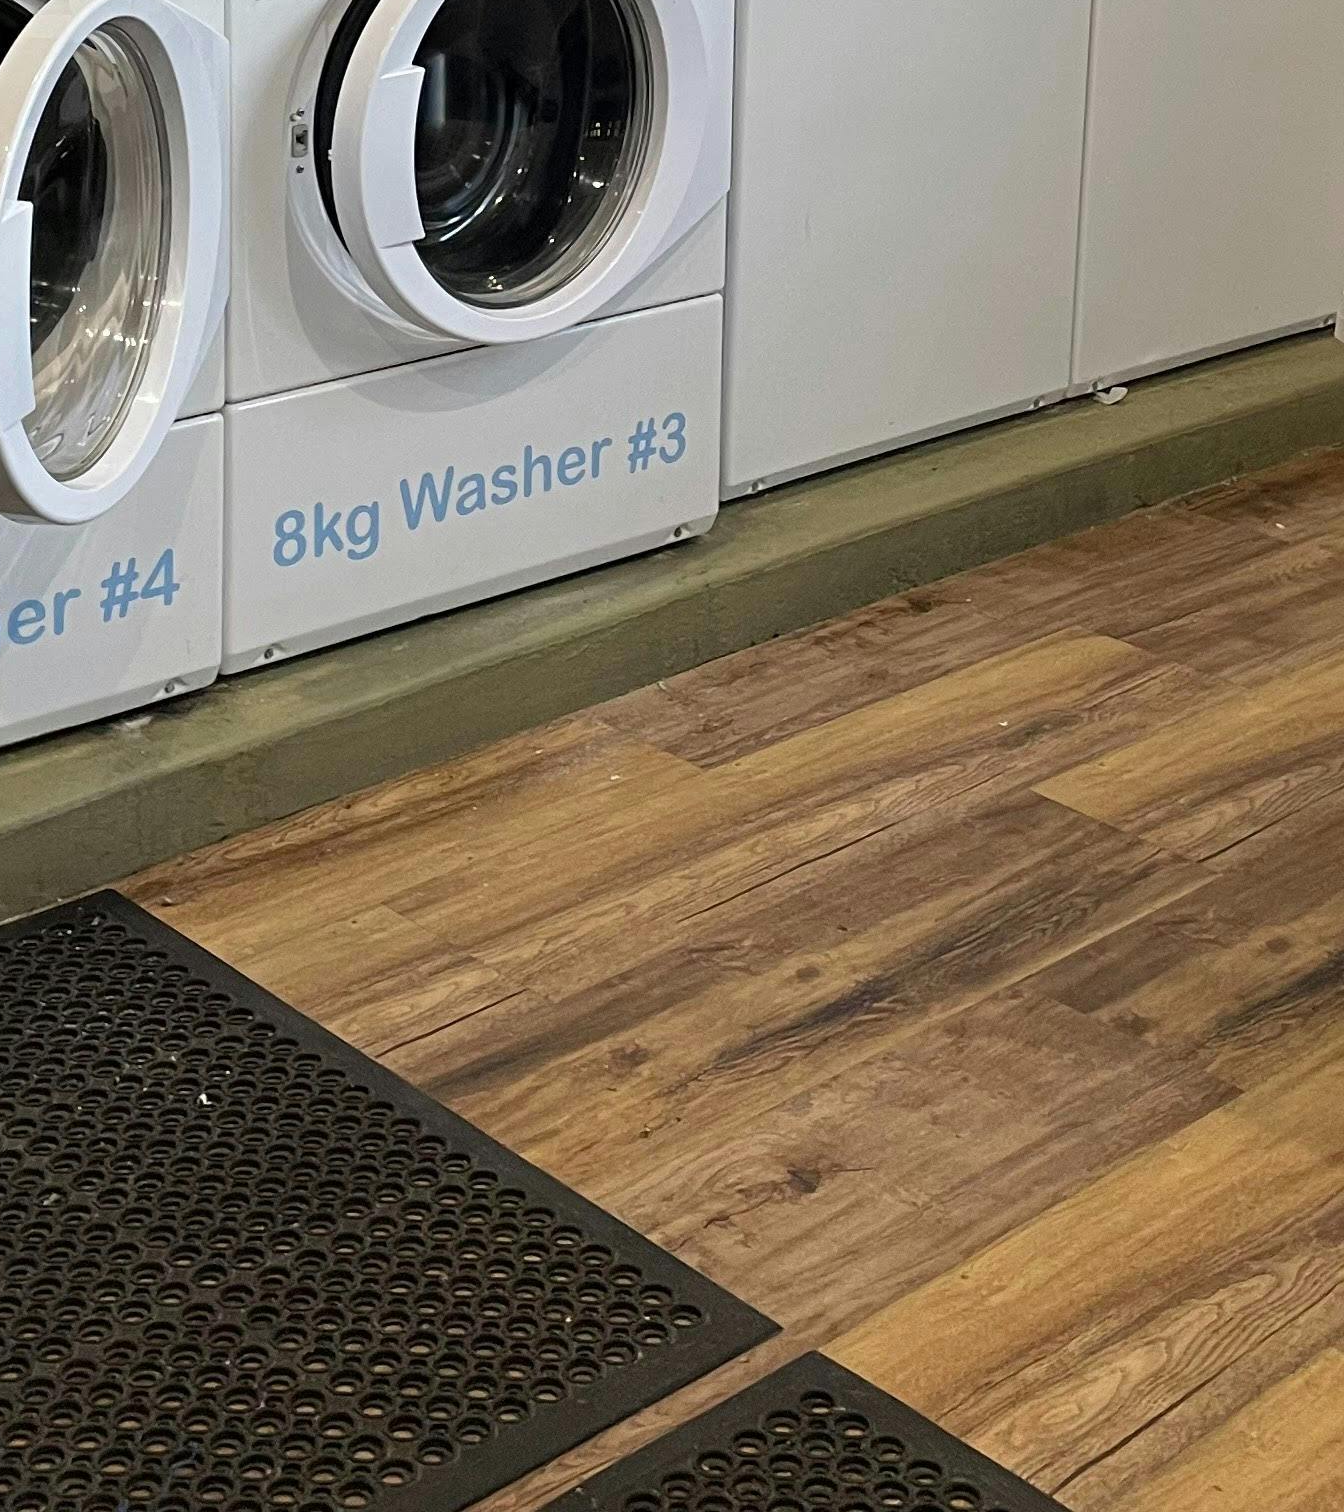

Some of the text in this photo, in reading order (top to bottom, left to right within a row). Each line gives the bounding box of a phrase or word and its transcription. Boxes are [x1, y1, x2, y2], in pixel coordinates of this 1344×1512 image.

[272, 412, 688, 567] 8kg Washer #3
[100, 547, 179, 622] #4
